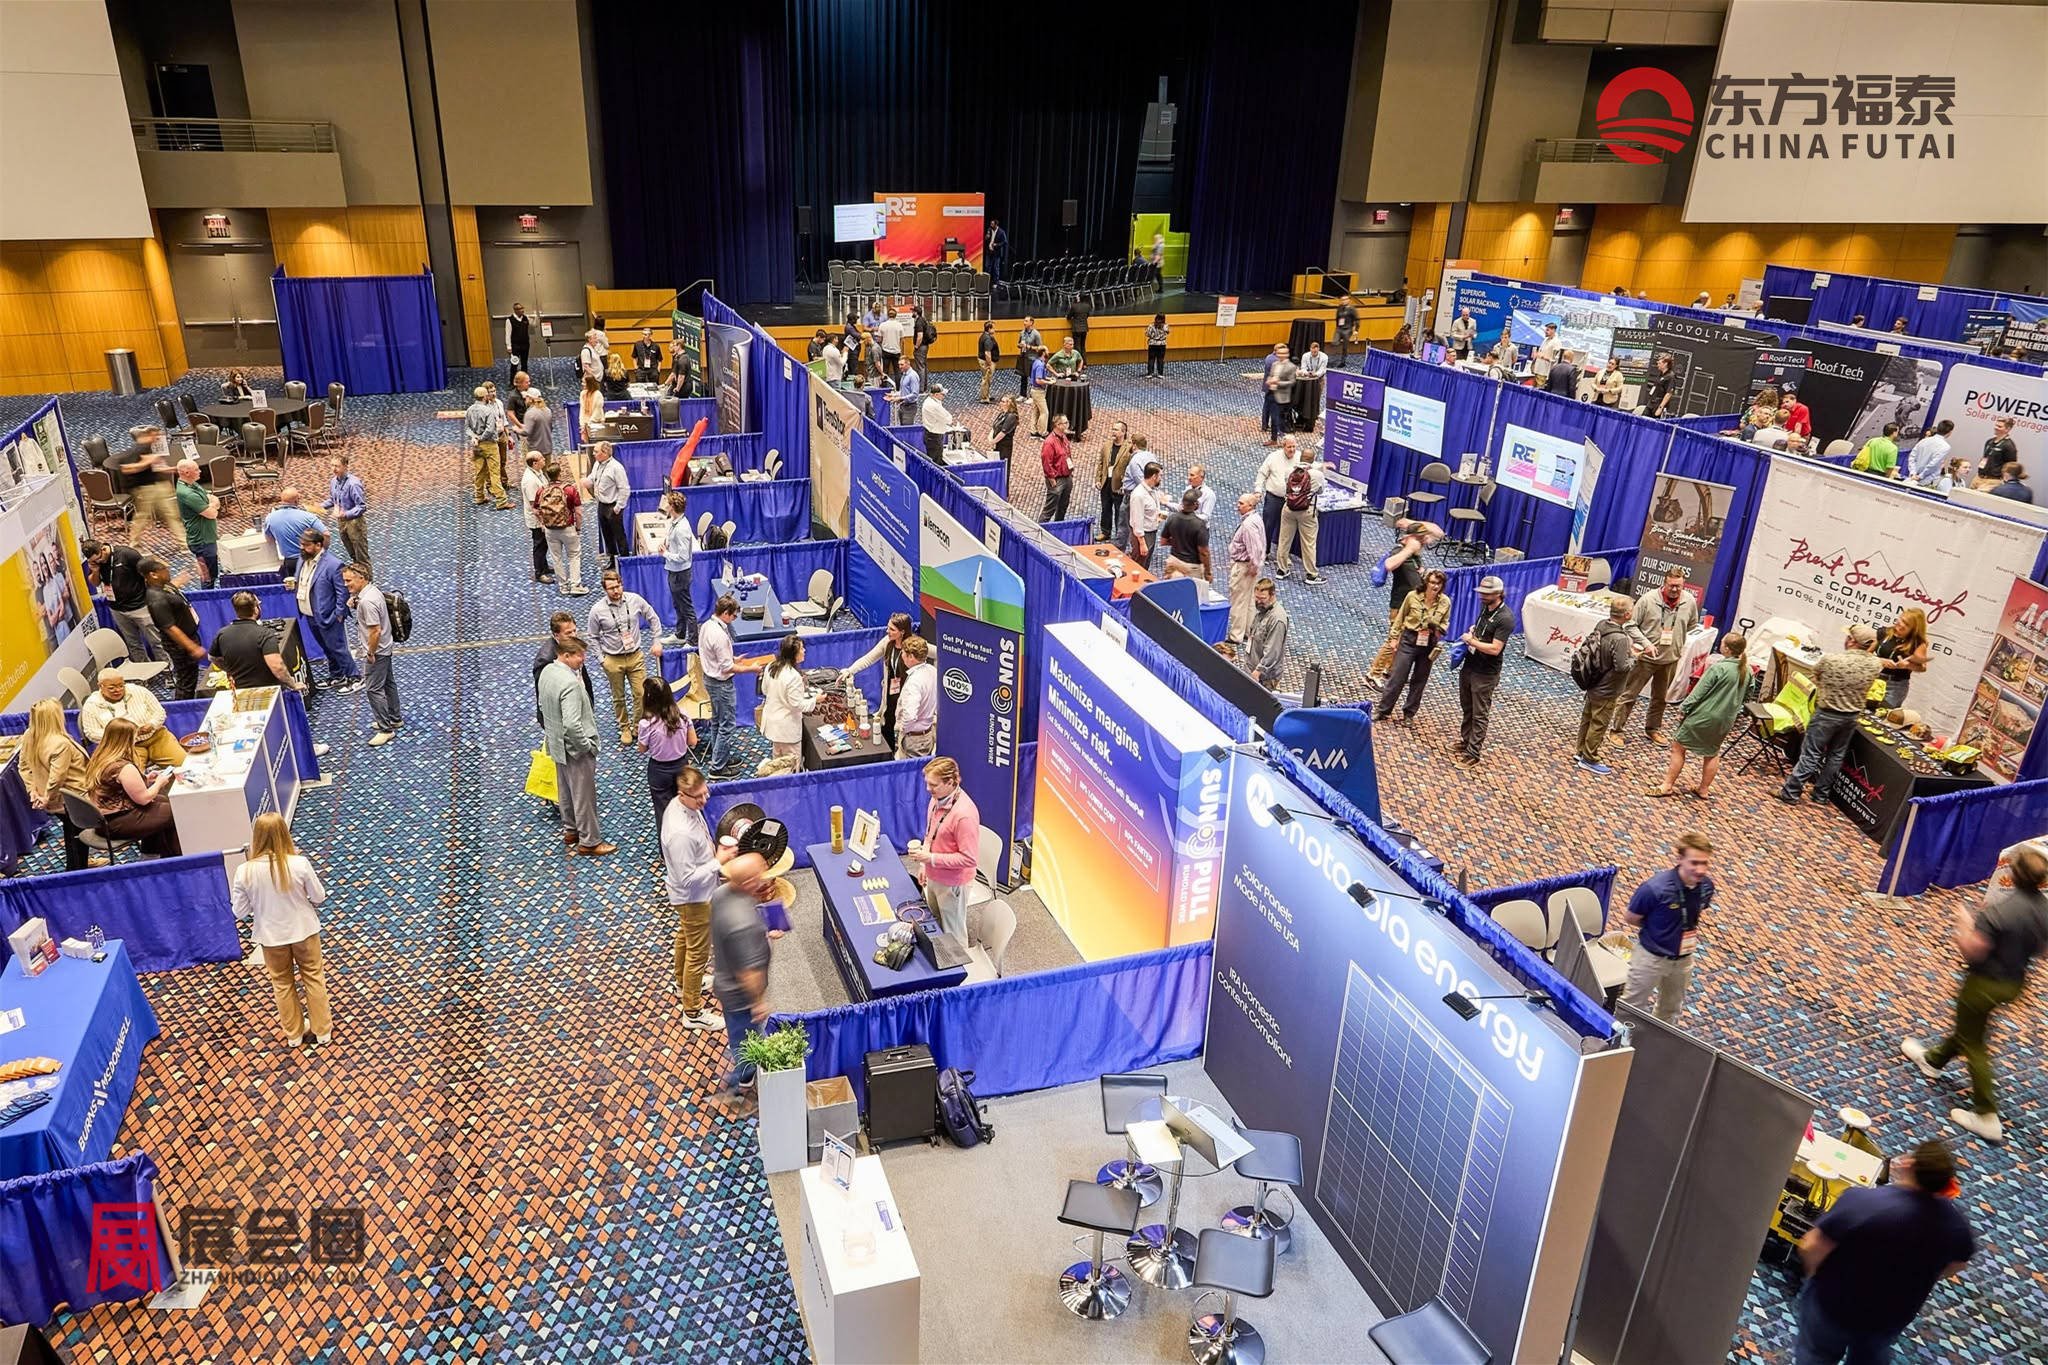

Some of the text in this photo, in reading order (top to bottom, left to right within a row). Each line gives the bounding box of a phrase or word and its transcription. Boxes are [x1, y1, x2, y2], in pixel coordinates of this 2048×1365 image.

[1769, 354, 1806, 364] Roof Tech
[1813, 359, 1839, 373] Roof
[1840, 364, 1864, 378] Tech
[1966, 407, 1989, 422] Solar
[1639, 571, 1647, 581] IS
[1642, 557, 1658, 570] OUR
[1783, 537, 1968, 624] Brent Scarbrough
[1777, 585, 1884, 632] 100% EMPLOYE
[1813, 574, 1907, 614] & COMPAN
[1825, 592, 1861, 612] SINCE
[942, 633, 994, 655] Get PV wire fast.
[942, 643, 962, 656] Install
[968, 651, 989, 663] faster.
[999, 637, 1015, 686] SUN
[947, 678, 970, 693] 100%
[1049, 656, 1094, 713] Maximize
[1095, 705, 1142, 762] margins.
[995, 716, 1012, 768] PULL
[1048, 684, 1089, 740] Minimize
[1090, 732, 1113, 766] risk.
[1201, 767, 1223, 824] SUN
[1188, 860, 1213, 923] PULL
[1241, 864, 1293, 924] Solar Panels
[1280, 821, 1410, 956] motoola
[1233, 875, 1300, 953] Made in the USA
[1217, 971, 1293, 1070] Content Compliant
[1229, 966, 1281, 1035] IRA Domestic
[78, 1101, 98, 1152] BURNS
